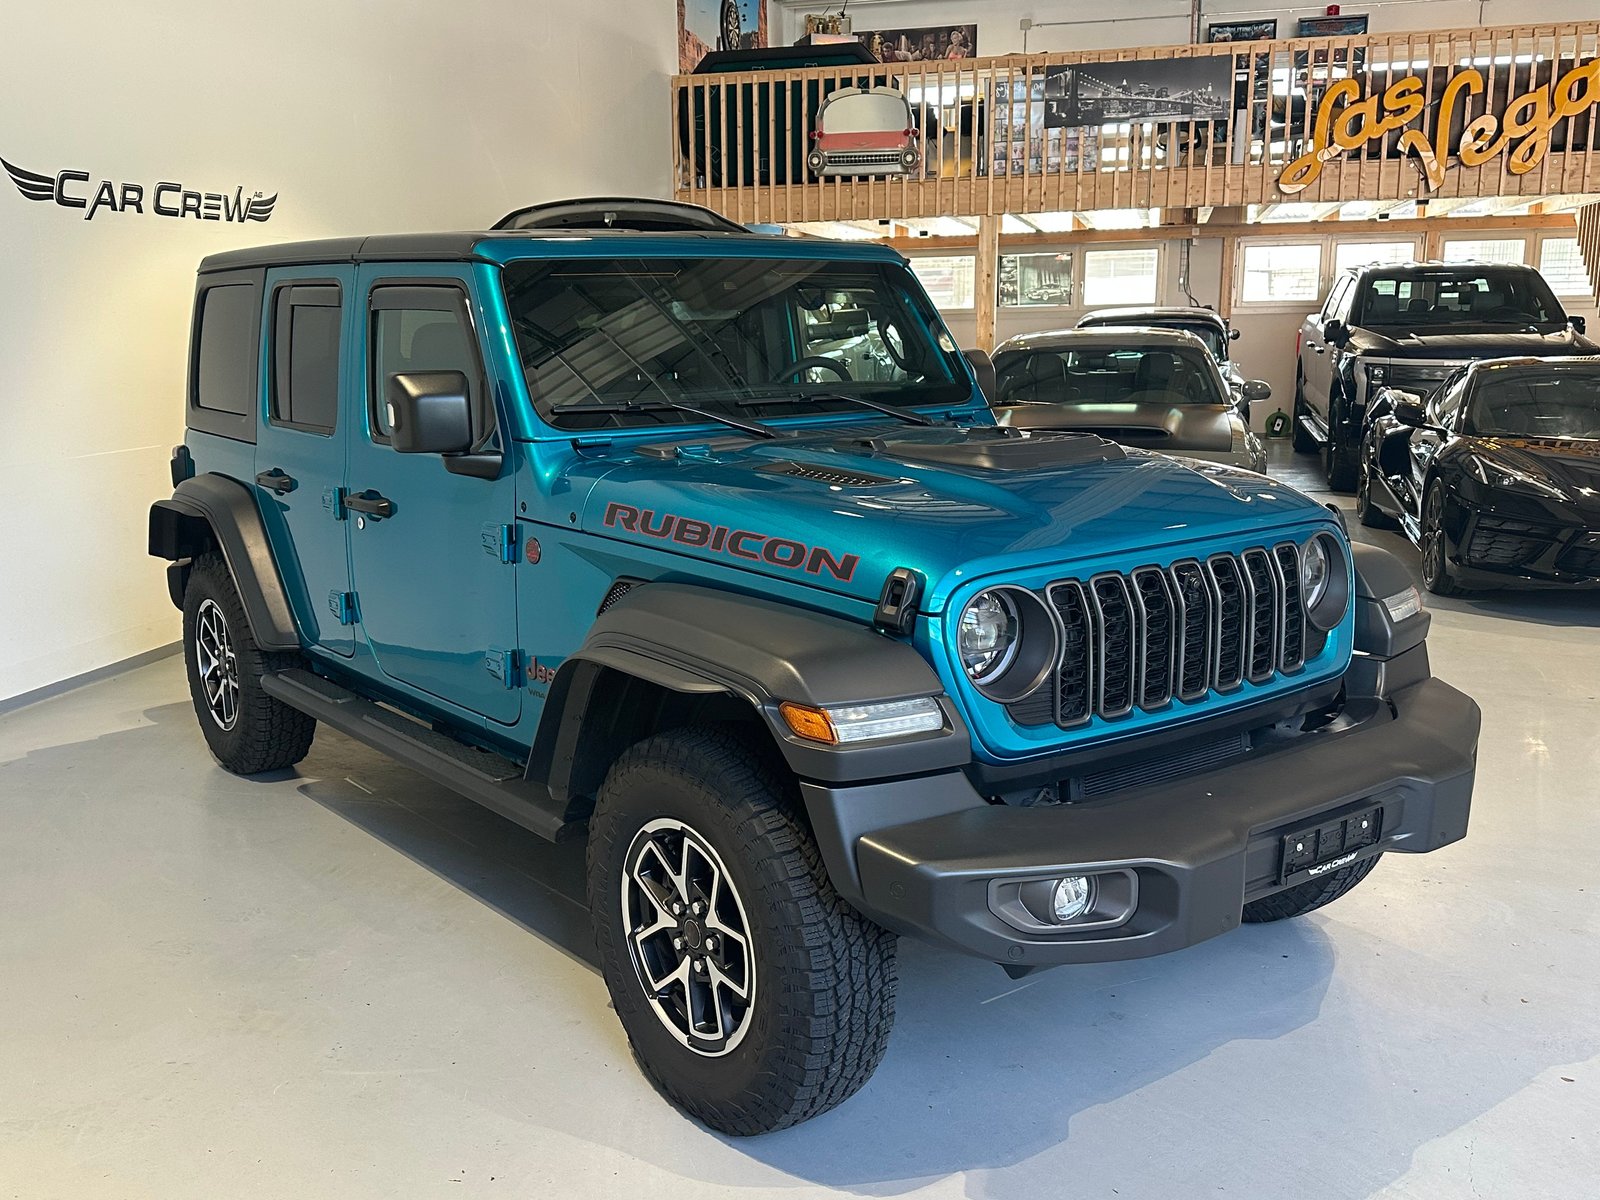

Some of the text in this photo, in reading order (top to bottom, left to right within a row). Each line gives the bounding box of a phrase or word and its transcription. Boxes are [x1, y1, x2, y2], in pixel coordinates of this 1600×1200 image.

[1278, 57, 1600, 194] Las Vega
[54, 169, 144, 220] CAR
[603, 502, 860, 583] RUBICON
[527, 655, 555, 683] Jee
